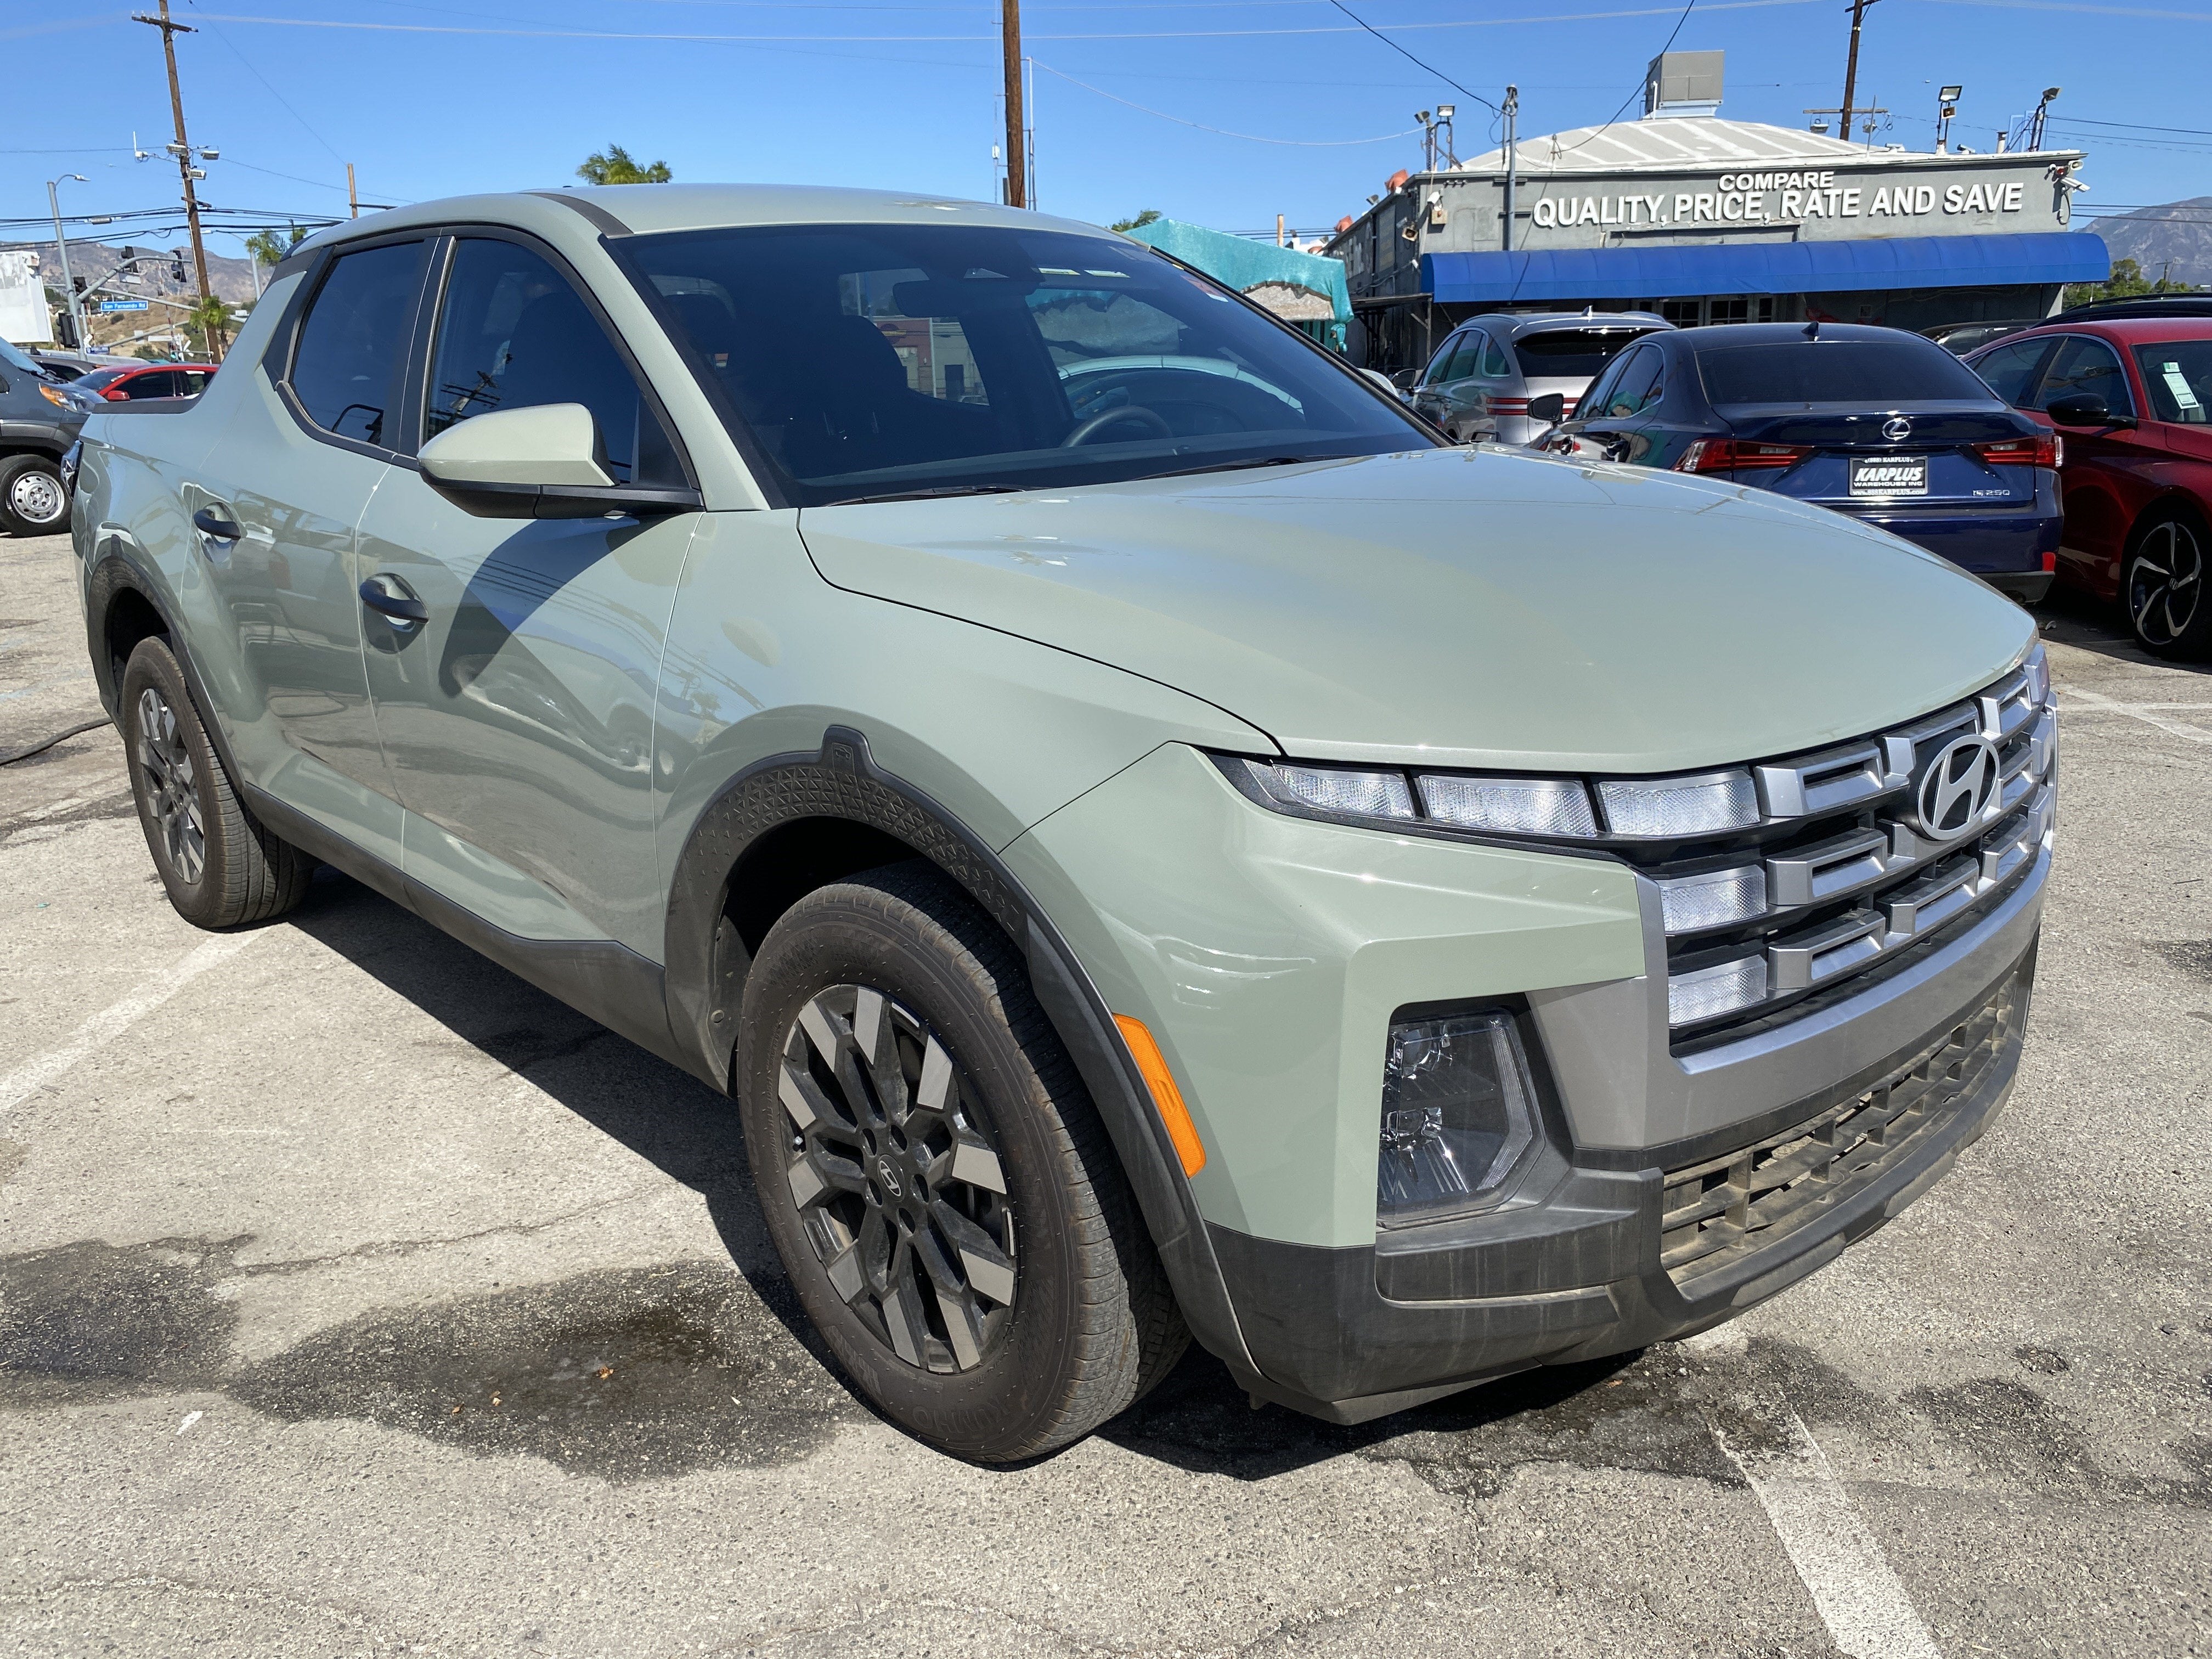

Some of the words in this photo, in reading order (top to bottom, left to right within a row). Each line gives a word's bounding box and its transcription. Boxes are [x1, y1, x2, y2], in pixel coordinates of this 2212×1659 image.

[1719, 171, 1835, 191] COMPARE
[1534, 193, 1668, 227] QUALITY,
[1674, 190, 1771, 224] PRICE,
[1781, 187, 1863, 218] RATE
[1869, 185, 1936, 215] AND
[1944, 182, 2025, 213] SAVE
[1854, 467, 1924, 482] KARPLUS
